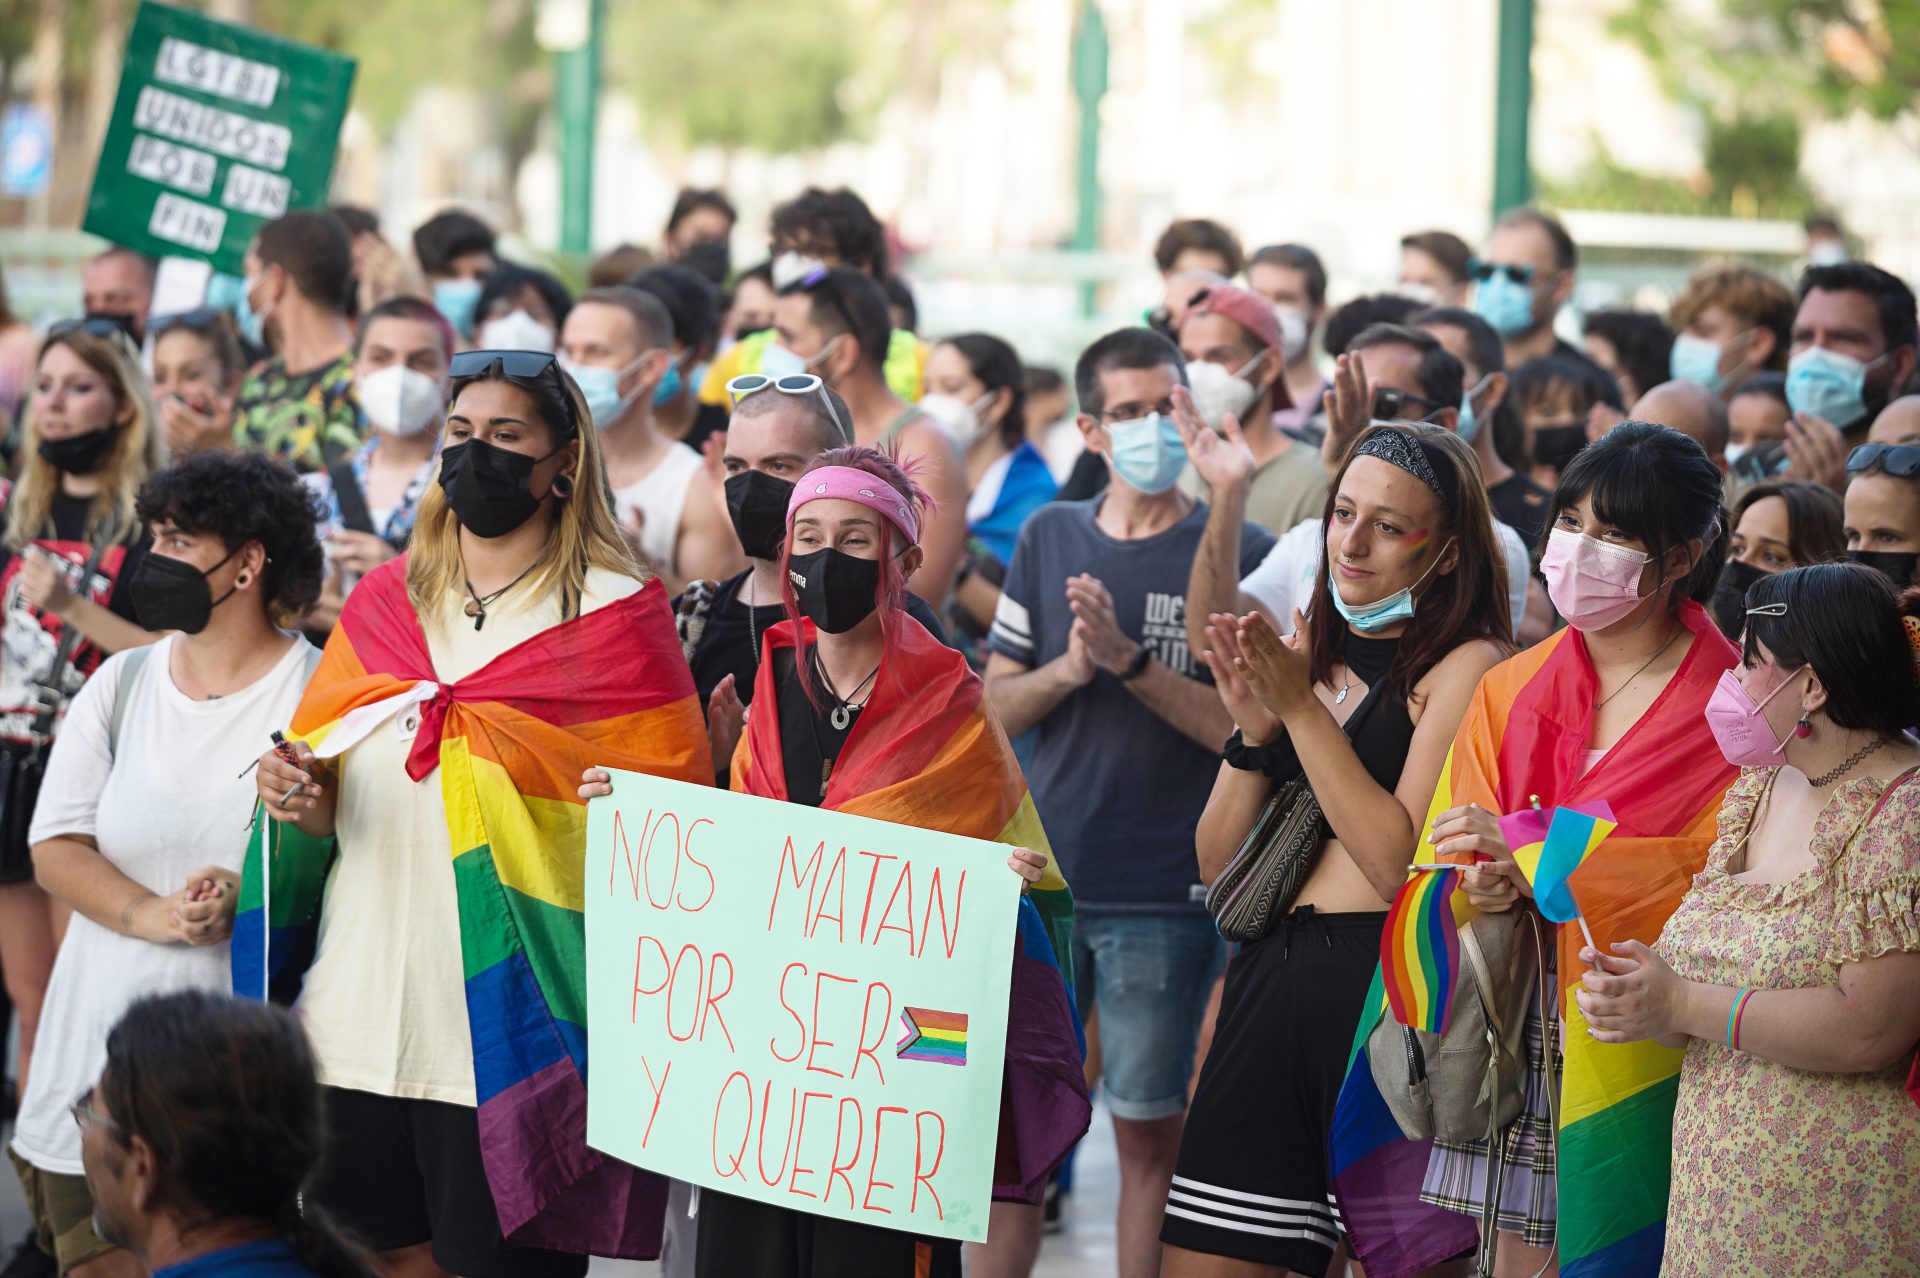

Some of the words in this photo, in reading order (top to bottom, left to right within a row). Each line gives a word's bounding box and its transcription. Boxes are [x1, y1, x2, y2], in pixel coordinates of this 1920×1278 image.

[163, 41, 271, 97] LGTBI
[146, 92, 282, 161] UNIDOS
[138, 138, 207, 185] POR
[233, 171, 282, 208] UN
[160, 203, 214, 241] FIN
[610, 809, 716, 912] NOS
[768, 835, 967, 959] MATAN
[632, 936, 735, 1053] POR
[770, 962, 893, 1085] SER
[641, 1056, 672, 1149] Y
[713, 1070, 945, 1221] QUERER
